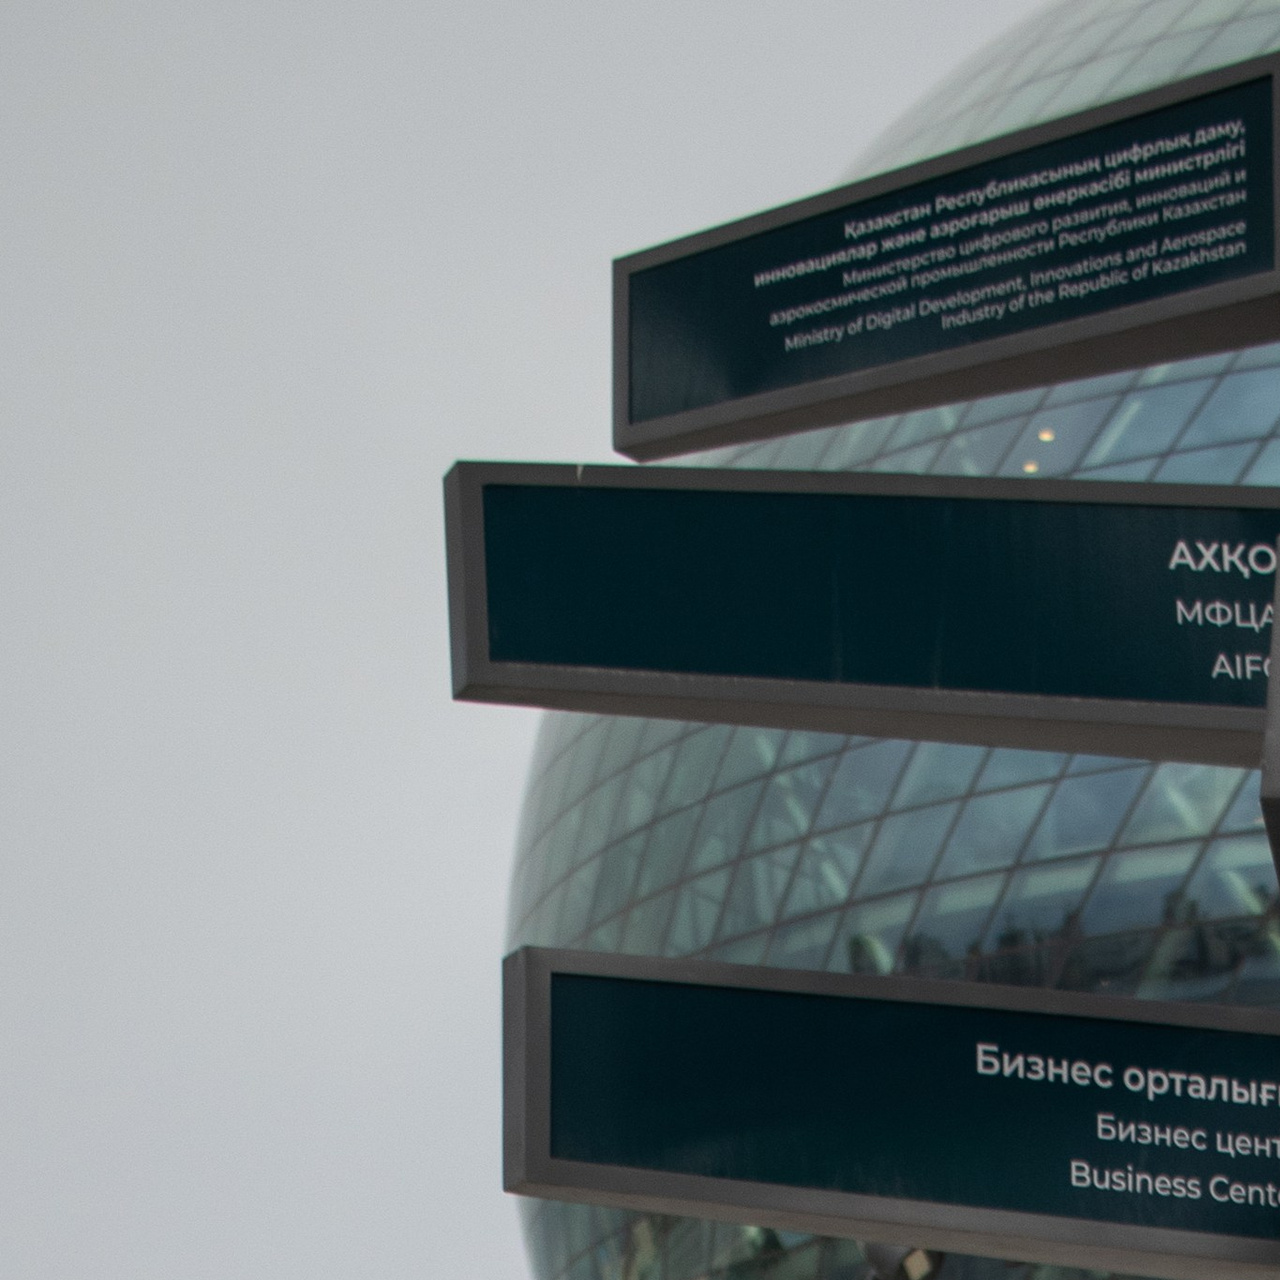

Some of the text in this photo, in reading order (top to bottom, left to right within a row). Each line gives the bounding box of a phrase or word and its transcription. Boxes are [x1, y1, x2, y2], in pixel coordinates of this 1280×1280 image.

[754, 139, 1246, 287] инновациялар және аэроғарыш өнеркәсібі министрлігі
[842, 169, 1247, 287] Министерство цифрового развития, инноваций и
[844, 203, 932, 239] Қазақстан
[935, 156, 1102, 214] Республикасының
[1104, 133, 1192, 168] цифрлық
[769, 190, 1247, 327] аэрокосмической промышленности Республики Казахстан
[784, 220, 1247, 352] Ministry of Digital Development, Innovations and Aerospace
[941, 240, 1247, 330] Industry of the Republic of Kazakhstan
[1168, 540, 1277, 579] АХҚО
[976, 1043, 1114, 1089] Бизнес
[1070, 1159, 1201, 1198] Business
[1096, 1113, 1207, 1151] Бизнес
